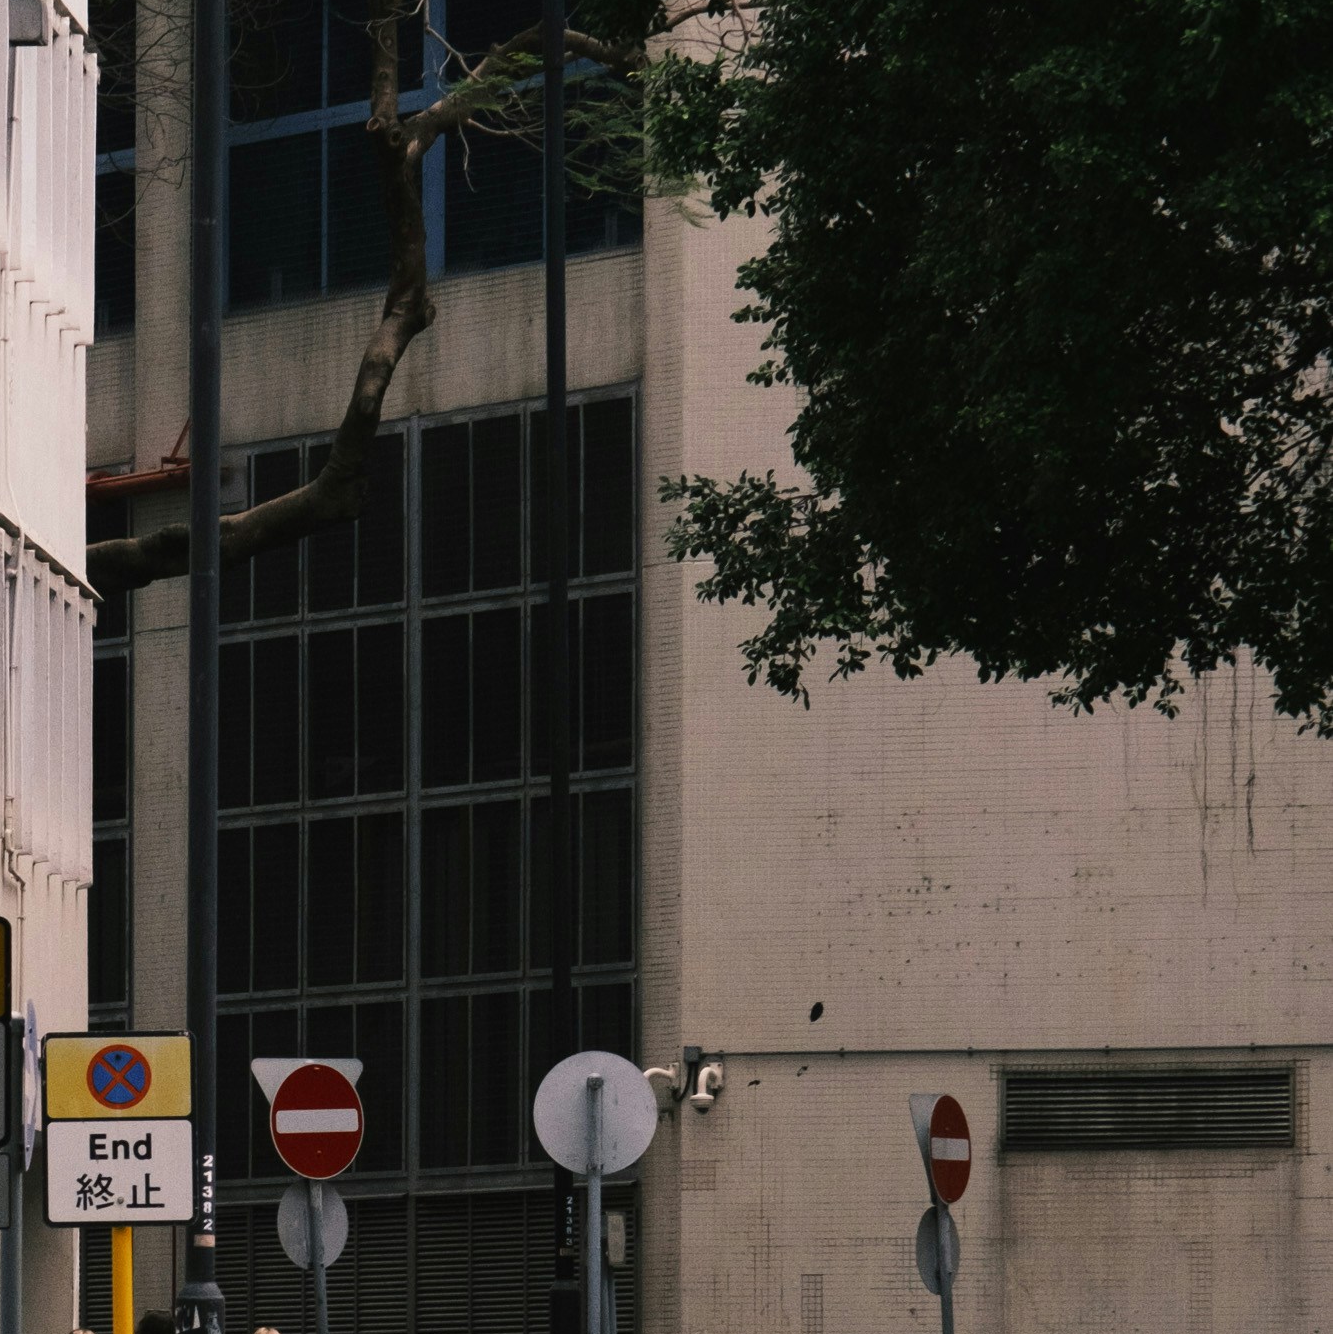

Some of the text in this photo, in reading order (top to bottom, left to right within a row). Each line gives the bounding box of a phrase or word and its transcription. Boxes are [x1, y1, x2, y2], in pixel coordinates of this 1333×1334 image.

[88, 1133, 153, 1161] End
[76, 1173, 165, 1211] 終止
[202, 1154, 214, 1231] 21382
